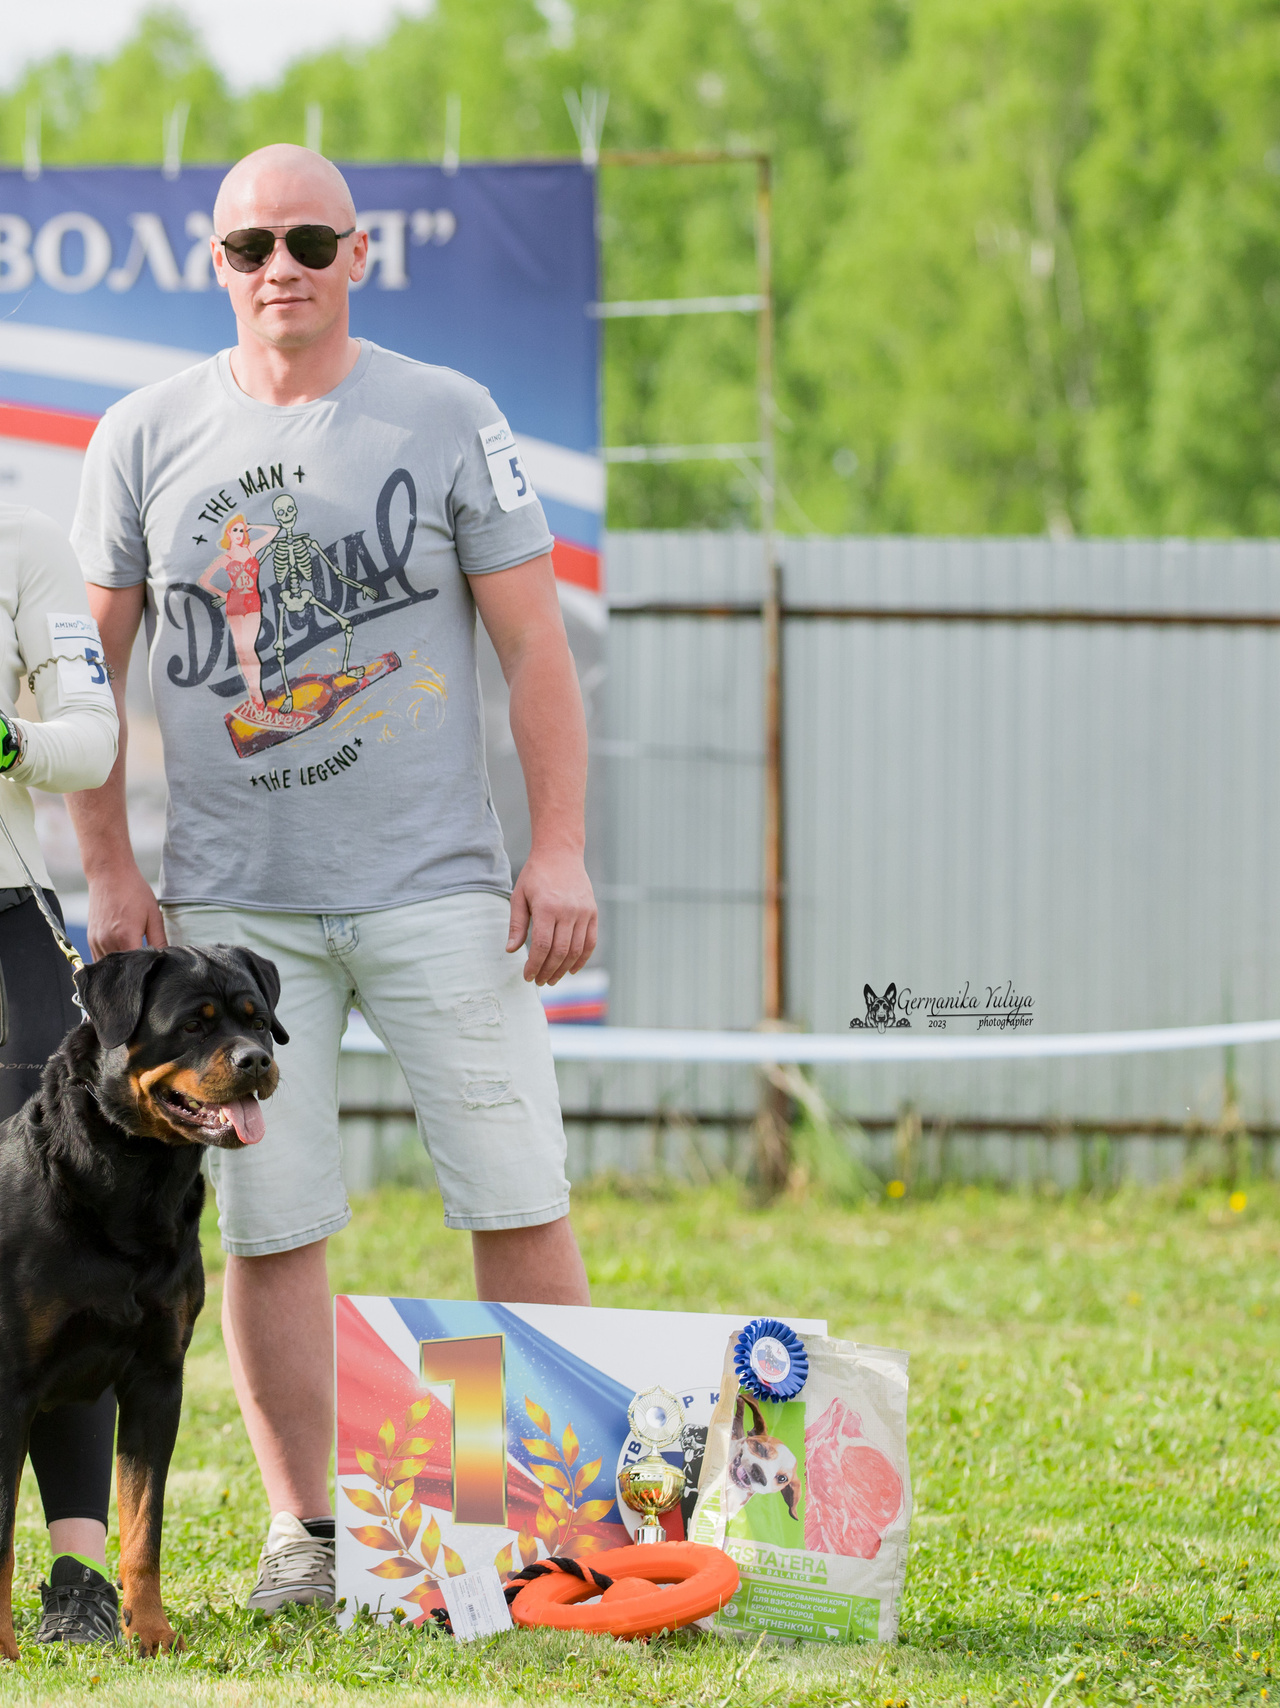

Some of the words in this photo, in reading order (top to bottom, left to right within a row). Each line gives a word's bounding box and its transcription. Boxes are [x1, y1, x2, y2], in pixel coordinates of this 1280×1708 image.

[198, 489, 237, 523] THE
[238, 463, 284, 498] MAN
[240, 576, 251, 586] 13
[258, 769, 291, 792] THE
[299, 744, 358, 786] LEGEND
[5, 1062, 46, 1070] DEMI
[419, 1333, 508, 1528] 1
[741, 1546, 828, 1575] STATERA
[767, 1568, 811, 1582] BALANCE
[752, 1595, 769, 1604] ДЛЯ
[770, 1597, 811, 1611] ВЗРОСЛЫХ
[812, 1603, 837, 1614] СОБАК
[753, 1586, 828, 1605] СБАЛАНСИРОВАННЫЙ
[829, 1598, 848, 1607] КОРМ
[751, 1602, 786, 1615] КРУПНЫХ
[788, 1608, 814, 1620] ПОРОД
[749, 1616, 757, 1624] С
[758, 1617, 813, 1634] ЯГНЕНКОМ
